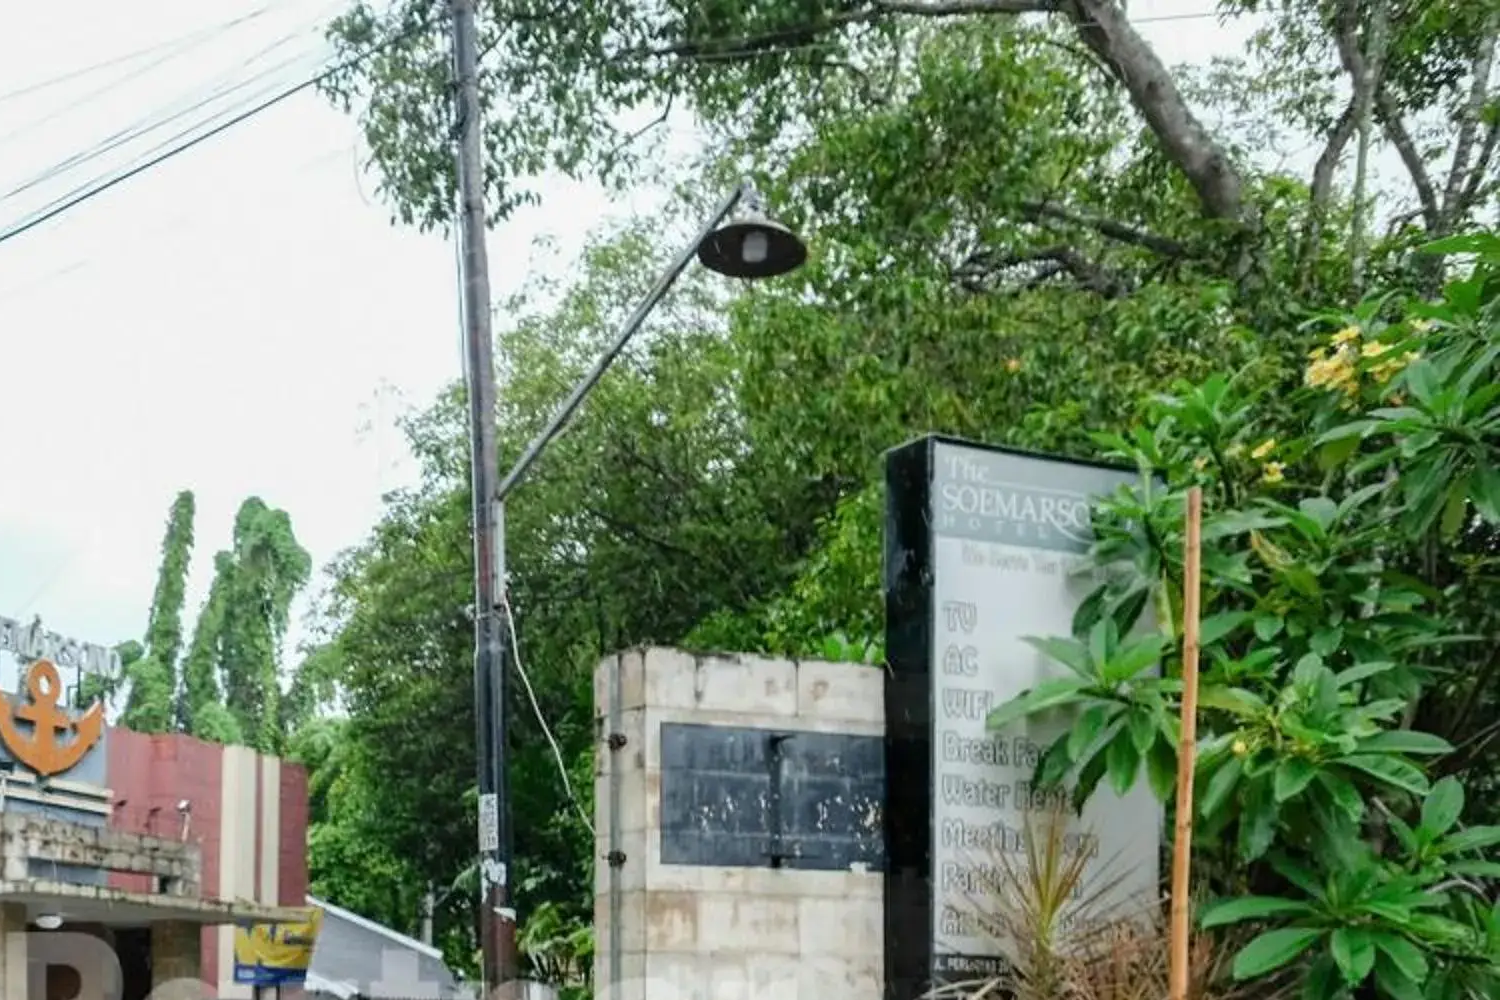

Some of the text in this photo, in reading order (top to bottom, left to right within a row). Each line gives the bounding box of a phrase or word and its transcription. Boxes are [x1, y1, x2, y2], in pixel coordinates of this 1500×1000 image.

[944, 455, 990, 482] The
[941, 484, 1092, 529] SOEMARSO
[943, 601, 977, 633] TV
[942, 645, 979, 676] AC
[942, 730, 1008, 766] Break
[941, 773, 1011, 810] Water
